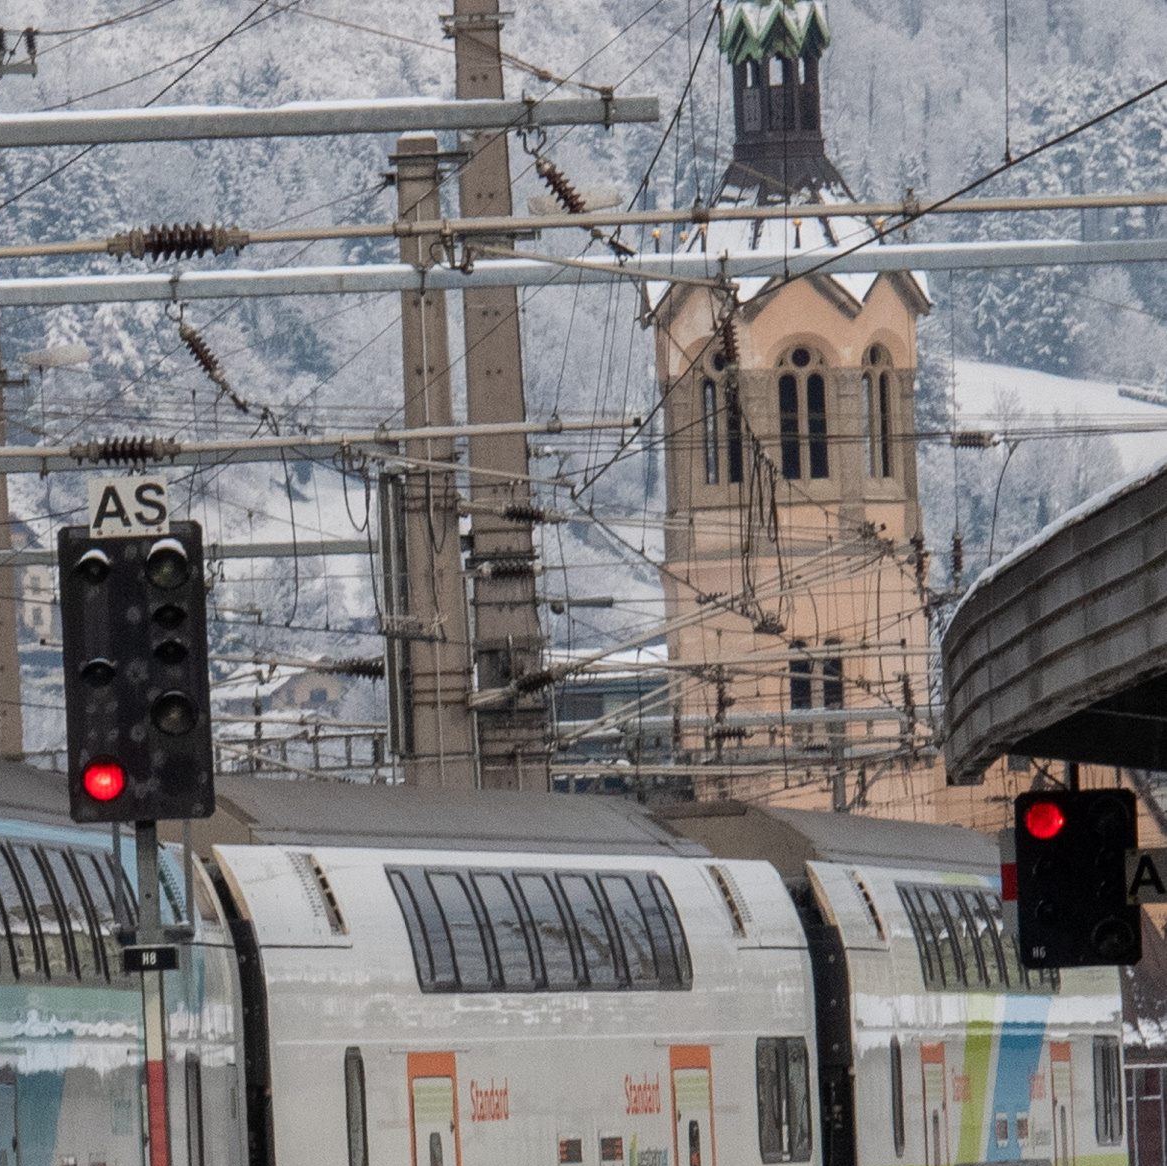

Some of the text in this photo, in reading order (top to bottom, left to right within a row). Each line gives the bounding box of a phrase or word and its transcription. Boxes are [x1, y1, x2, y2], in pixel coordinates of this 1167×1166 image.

[92, 482, 167, 529] AS
[1129, 854, 1166, 896] A
[470, 1076, 509, 1122] Standard
[625, 1071, 661, 1116] Standard
